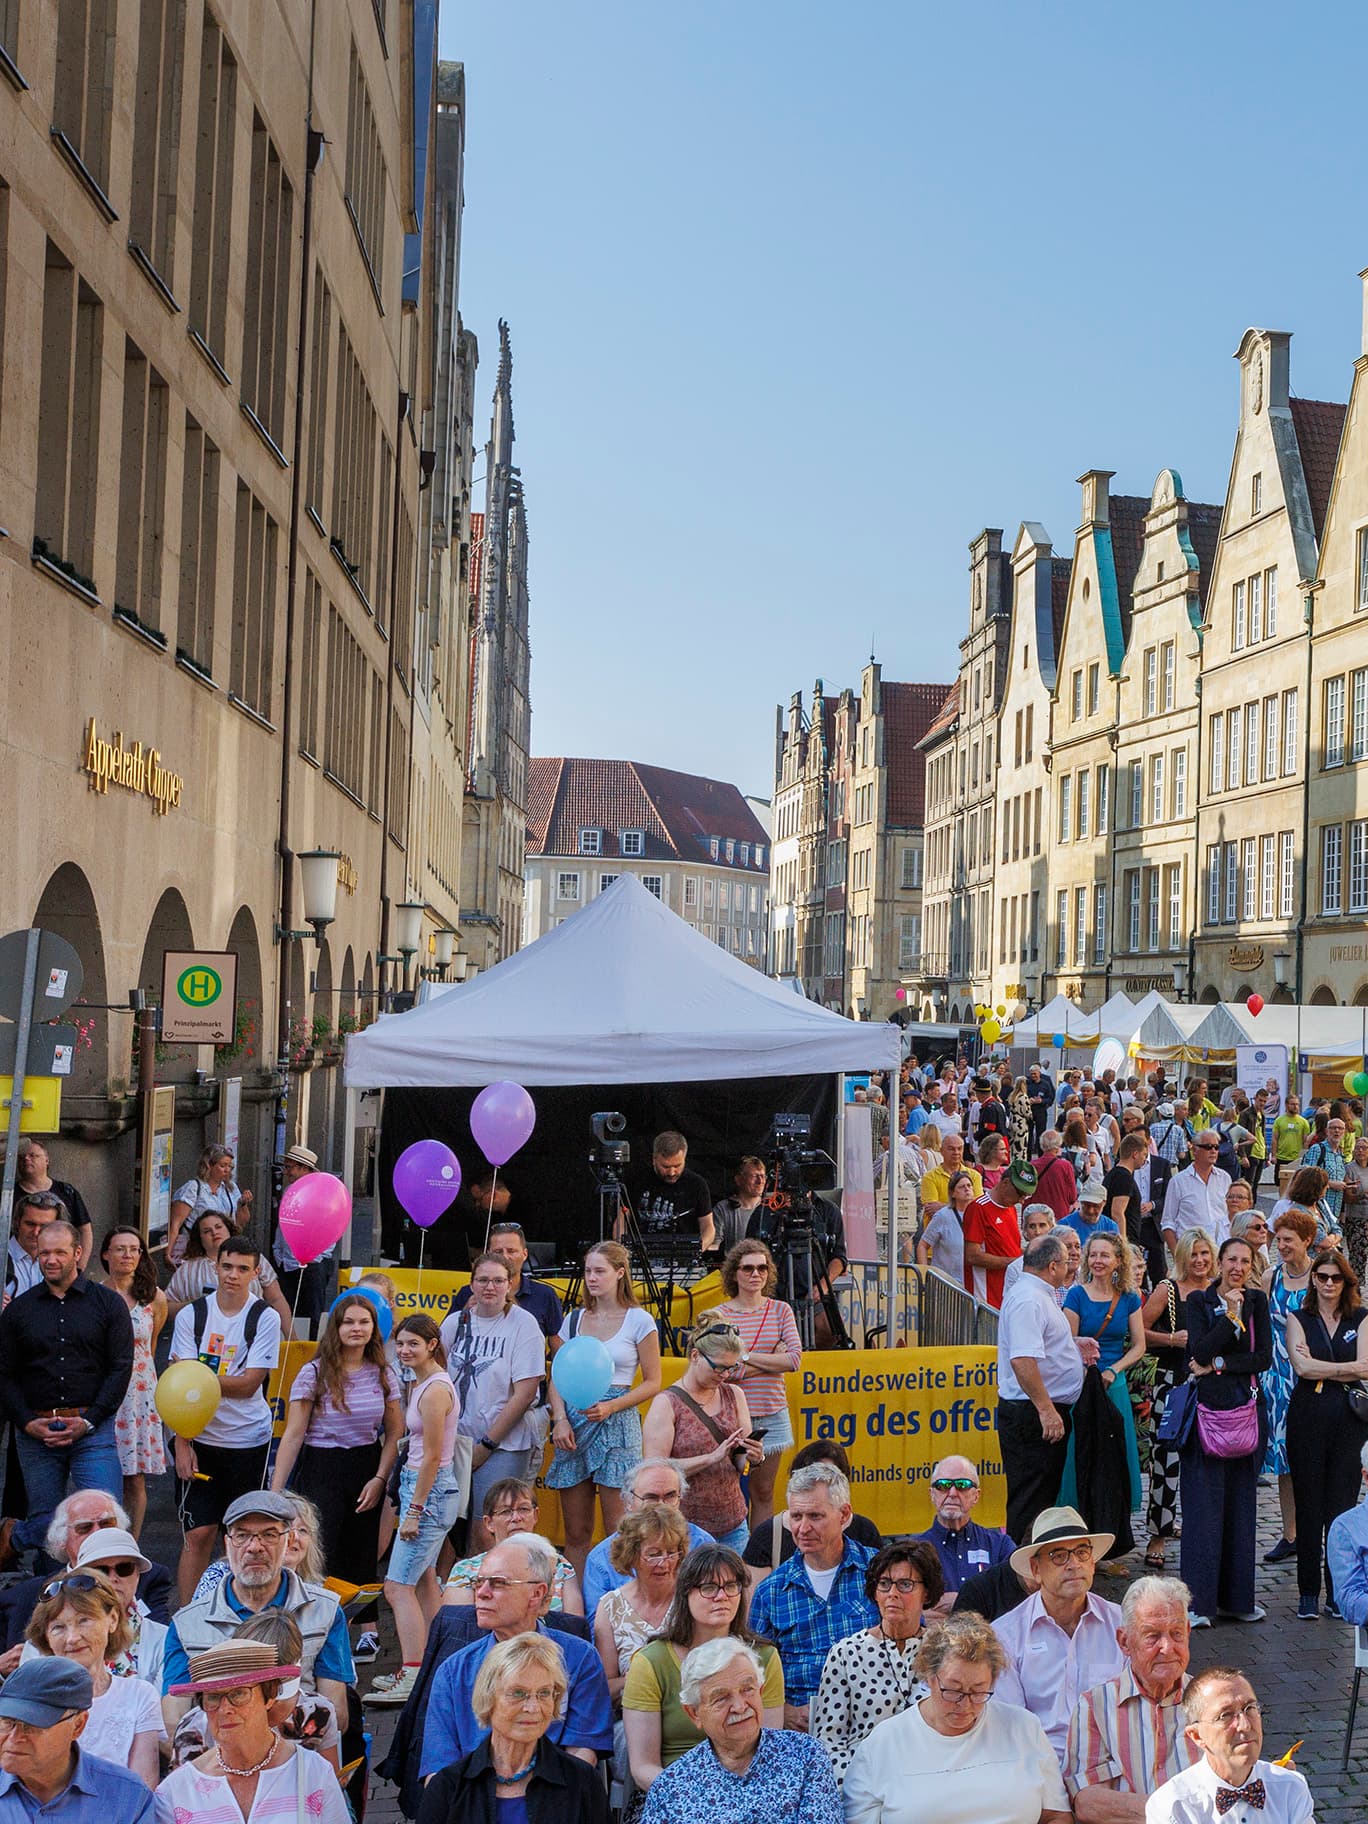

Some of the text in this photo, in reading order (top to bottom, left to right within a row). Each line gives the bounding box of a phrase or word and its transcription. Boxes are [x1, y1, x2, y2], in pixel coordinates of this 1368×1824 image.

[1329, 945, 1363, 965] JUWELIER
[190, 974, 209, 998] H
[174, 1020, 222, 1028] Prinzipalmarkt
[802, 1366, 947, 1395] Bundesweite
[800, 1406, 857, 1448] Tag
[866, 1403, 921, 1436] des
[850, 1464, 903, 1483] hlands
